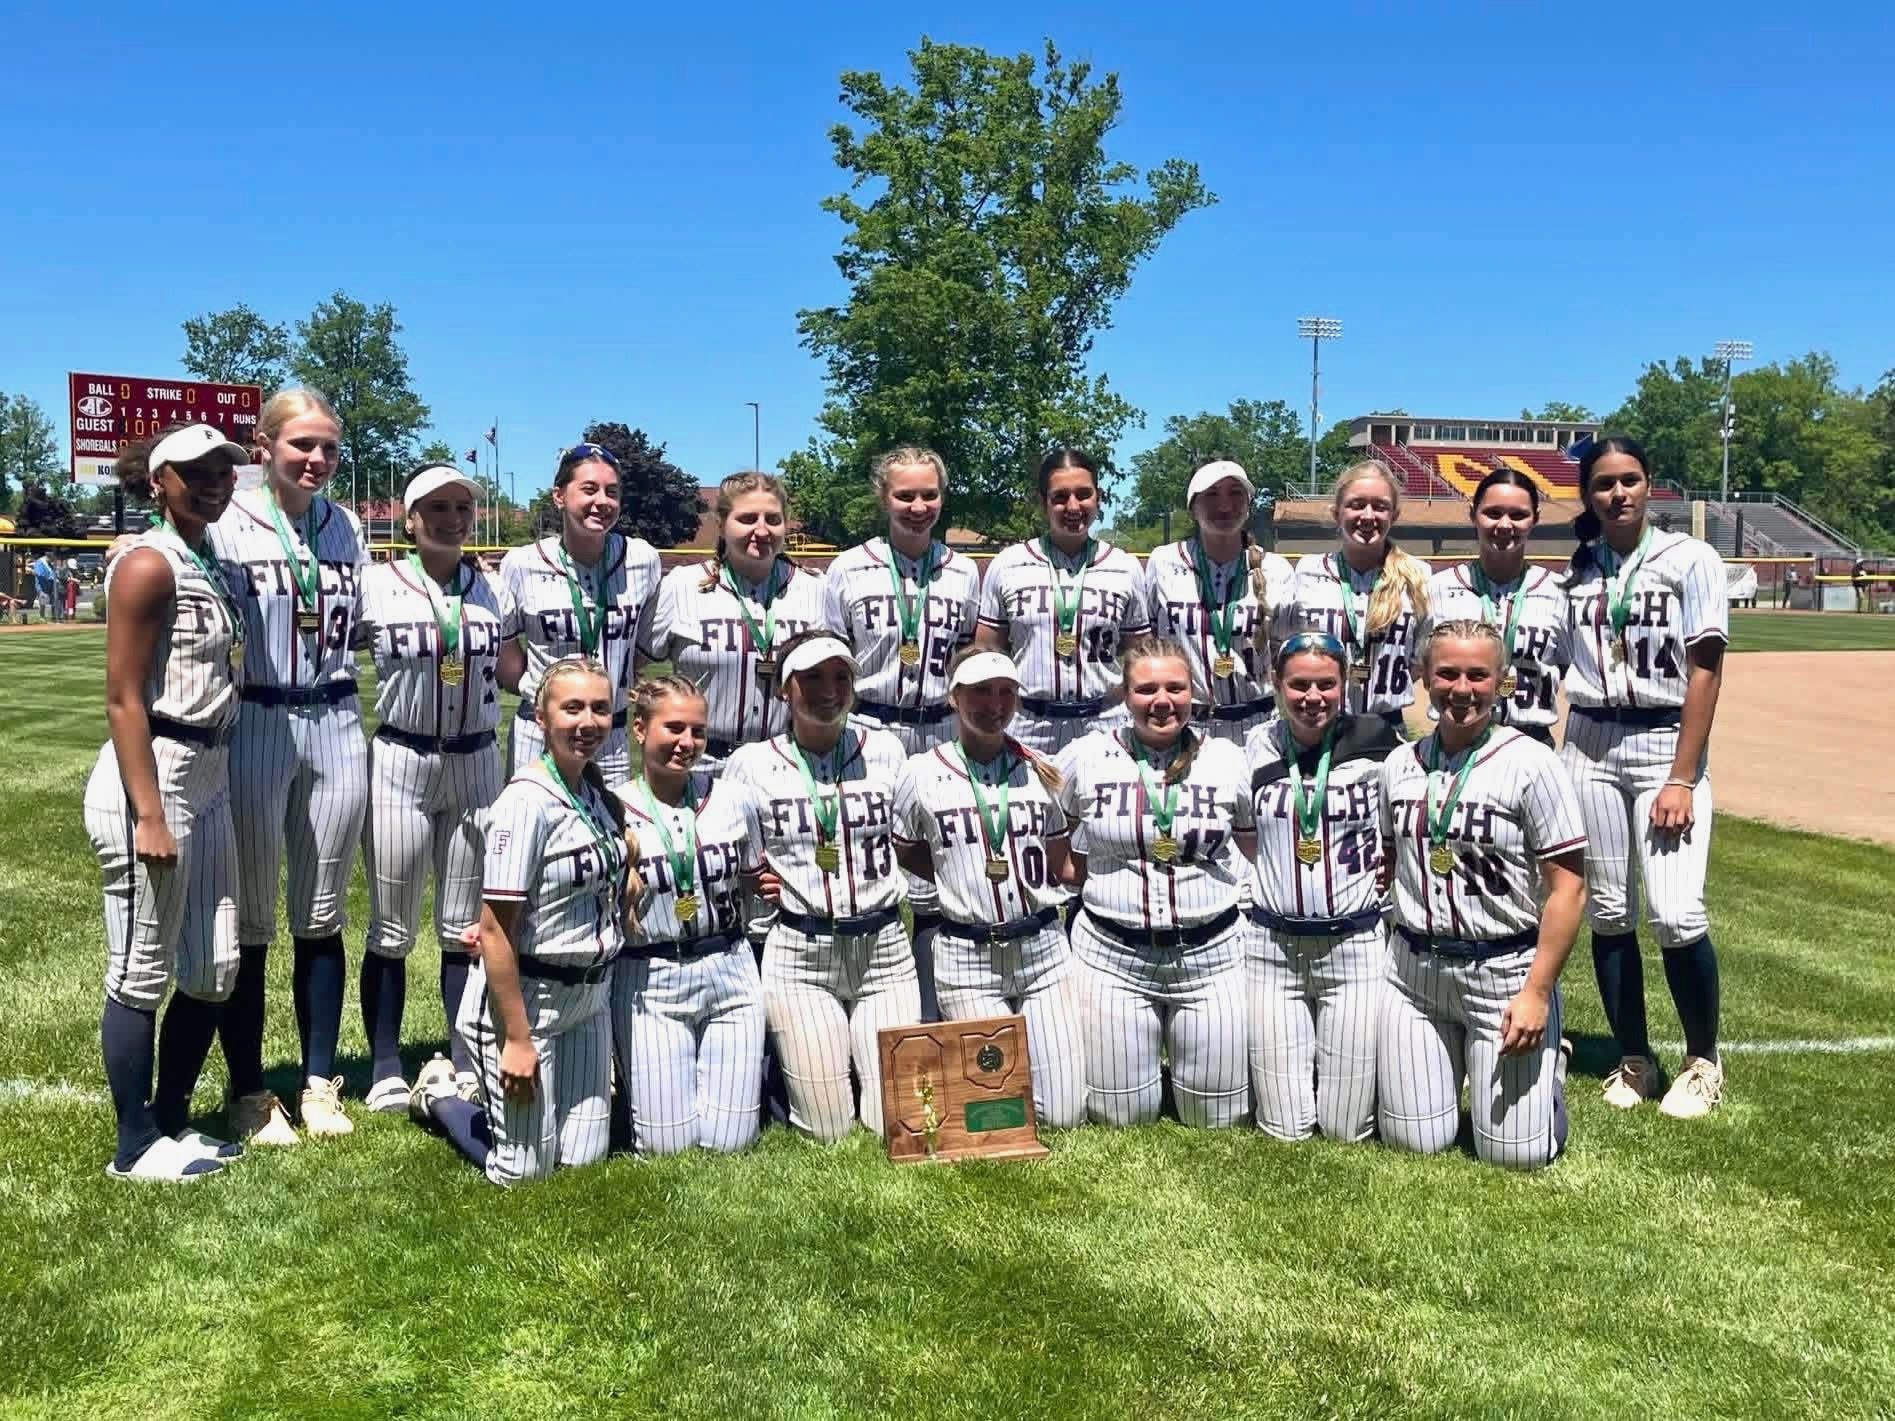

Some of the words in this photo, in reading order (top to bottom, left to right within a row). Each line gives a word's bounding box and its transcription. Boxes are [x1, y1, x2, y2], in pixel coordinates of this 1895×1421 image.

[88, 383, 115, 396] BALL
[121, 383, 130, 400] 0
[146, 387, 182, 401] STRIKE
[186, 388, 196, 404] 0
[217, 392, 236, 405] OUT
[241, 392, 250, 408] 0
[120, 406, 126, 417] 1
[136, 407, 143, 418] 2
[151, 408, 159, 419] 3
[170, 409, 177, 420] 4
[185, 410, 192, 421] 5
[200, 411, 207, 422] 6
[217, 412, 224, 423] 7
[232, 413, 257, 424] RUNS
[76, 417, 115, 433] GUEST
[385, 621, 501, 660] FICH
[1635, 634, 1679, 679] 14
[1373, 653, 1409, 696] 16
[862, 834, 892, 880] 13
